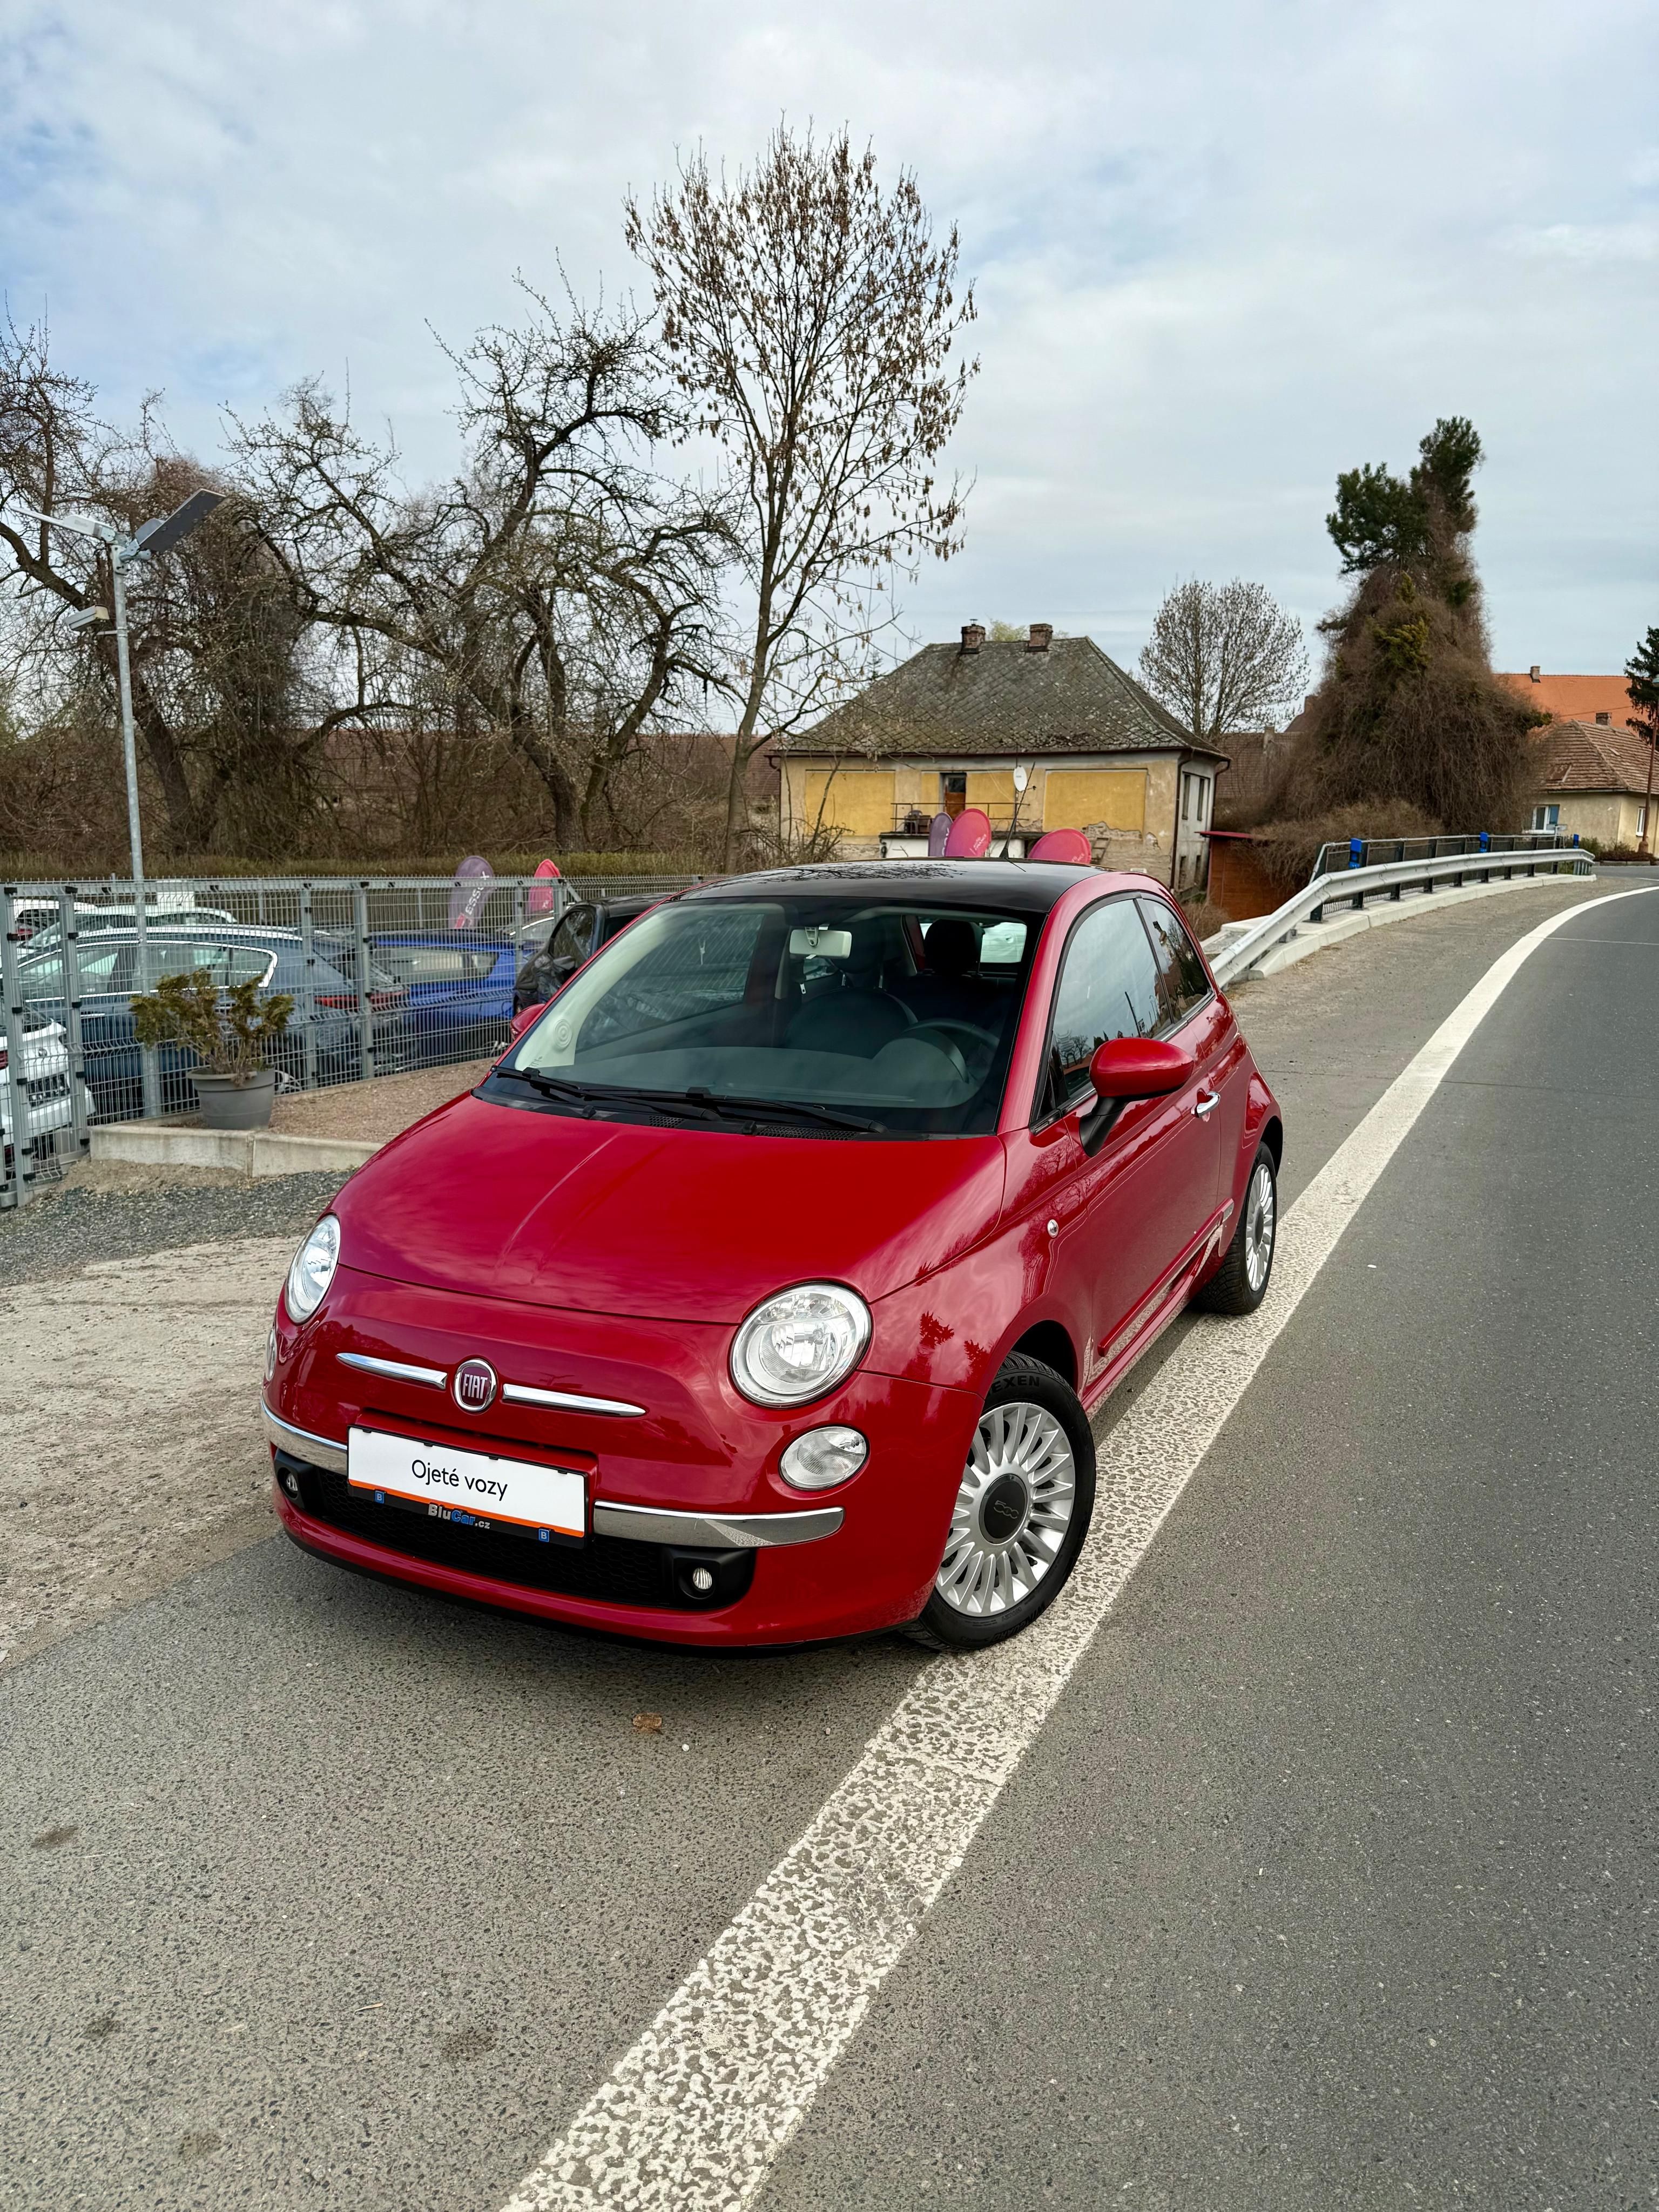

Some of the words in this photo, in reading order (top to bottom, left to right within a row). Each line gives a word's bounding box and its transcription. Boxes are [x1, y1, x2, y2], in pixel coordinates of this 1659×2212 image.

[462, 1373, 488, 1399] FIAT
[989, 1375, 1040, 1394] EXEN
[412, 1459, 459, 1487] Ojeté
[464, 1476, 508, 1501] vozy
[428, 1503, 490, 1529] BluCar.cz
[993, 1499, 1019, 1520] 500
